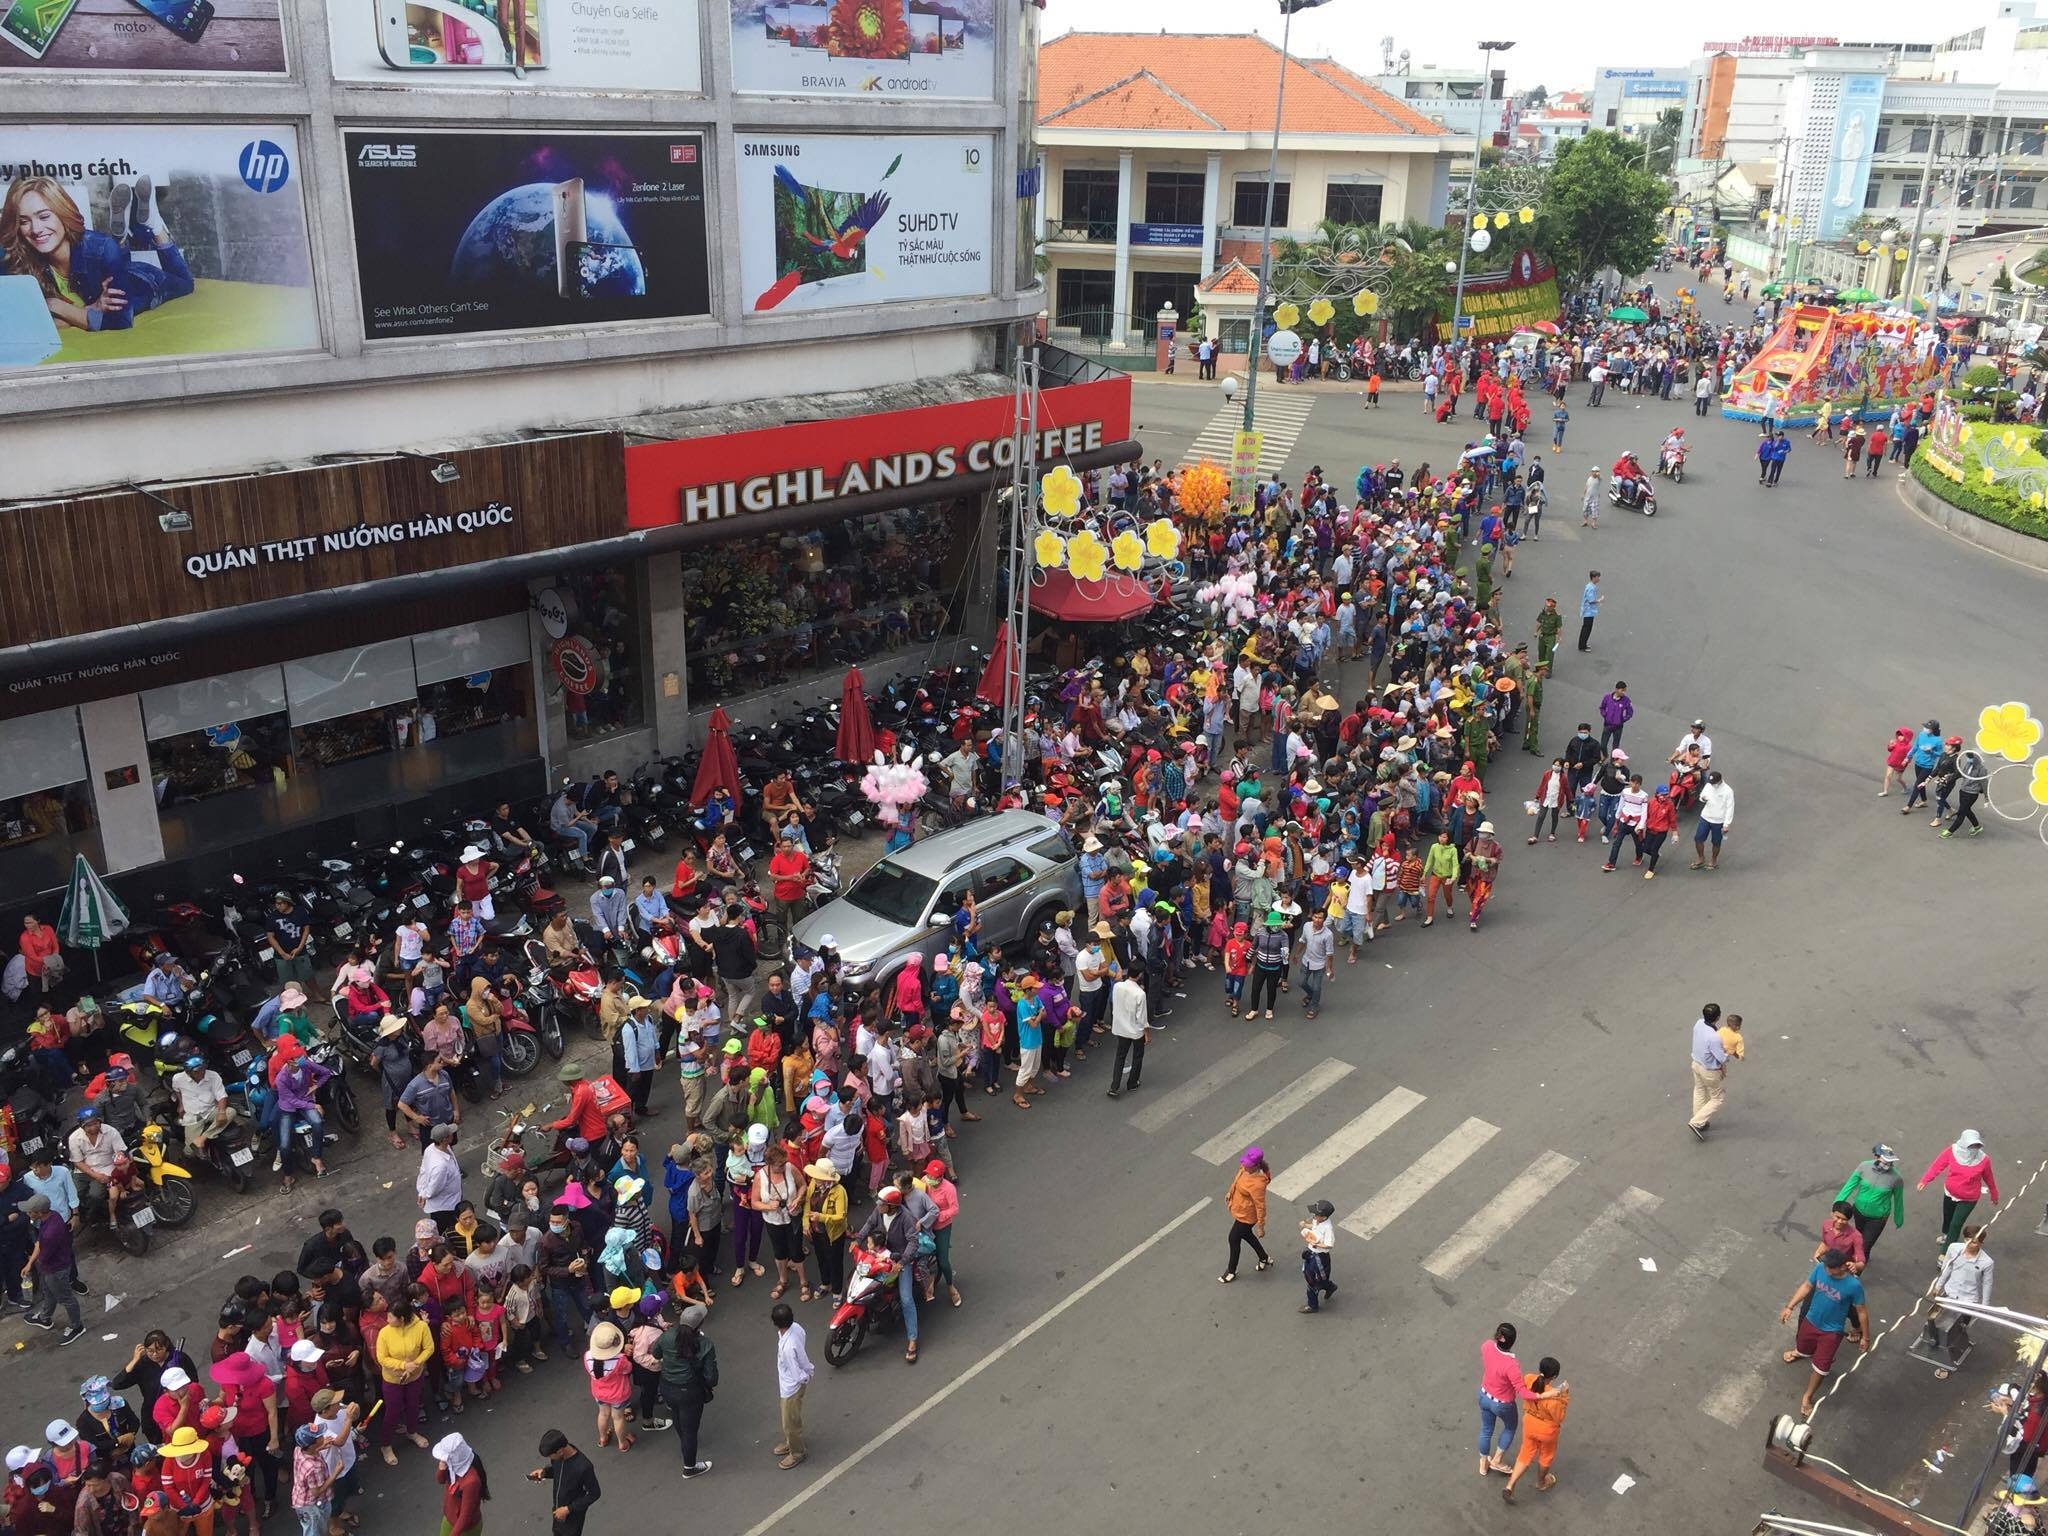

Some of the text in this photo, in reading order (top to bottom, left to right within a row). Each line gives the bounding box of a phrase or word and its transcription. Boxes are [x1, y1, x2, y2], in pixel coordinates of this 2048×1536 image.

[571, 2, 659, 21] Chuyên Gia Selfie
[113, 20, 147, 33] moto
[801, 75, 847, 88] BRAVIA
[1604, 69, 1655, 79] Sacombank
[358, 144, 417, 160] ASUS
[744, 143, 800, 157] SAMSUNG
[965, 148, 980, 165] 10
[18, 160, 83, 181] phong
[87, 157, 138, 177] cách.
[247, 140, 284, 193] hp
[662, 182, 667, 191] 2
[668, 182, 686, 191] Laser
[898, 212, 959, 233] SUHD TV
[909, 237, 924, 252] SẮC
[926, 239, 944, 250] MÀU
[898, 248, 981, 268] THẬT NHƯ CUỘC SỐNG
[374, 301, 489, 318] See What Others Can't See
[374, 316, 454, 329] www.asus.com/zenfone2
[683, 420, 1103, 523] HIGHLANDS COFFEE
[186, 502, 513, 578] QUÁN THỊT NƯỚNG HÀN QUỐC
[8, 649, 181, 693] QUÁN THỊT NƯỚNG HÀN QUỐC
[559, 671, 590, 691] COFFEE
